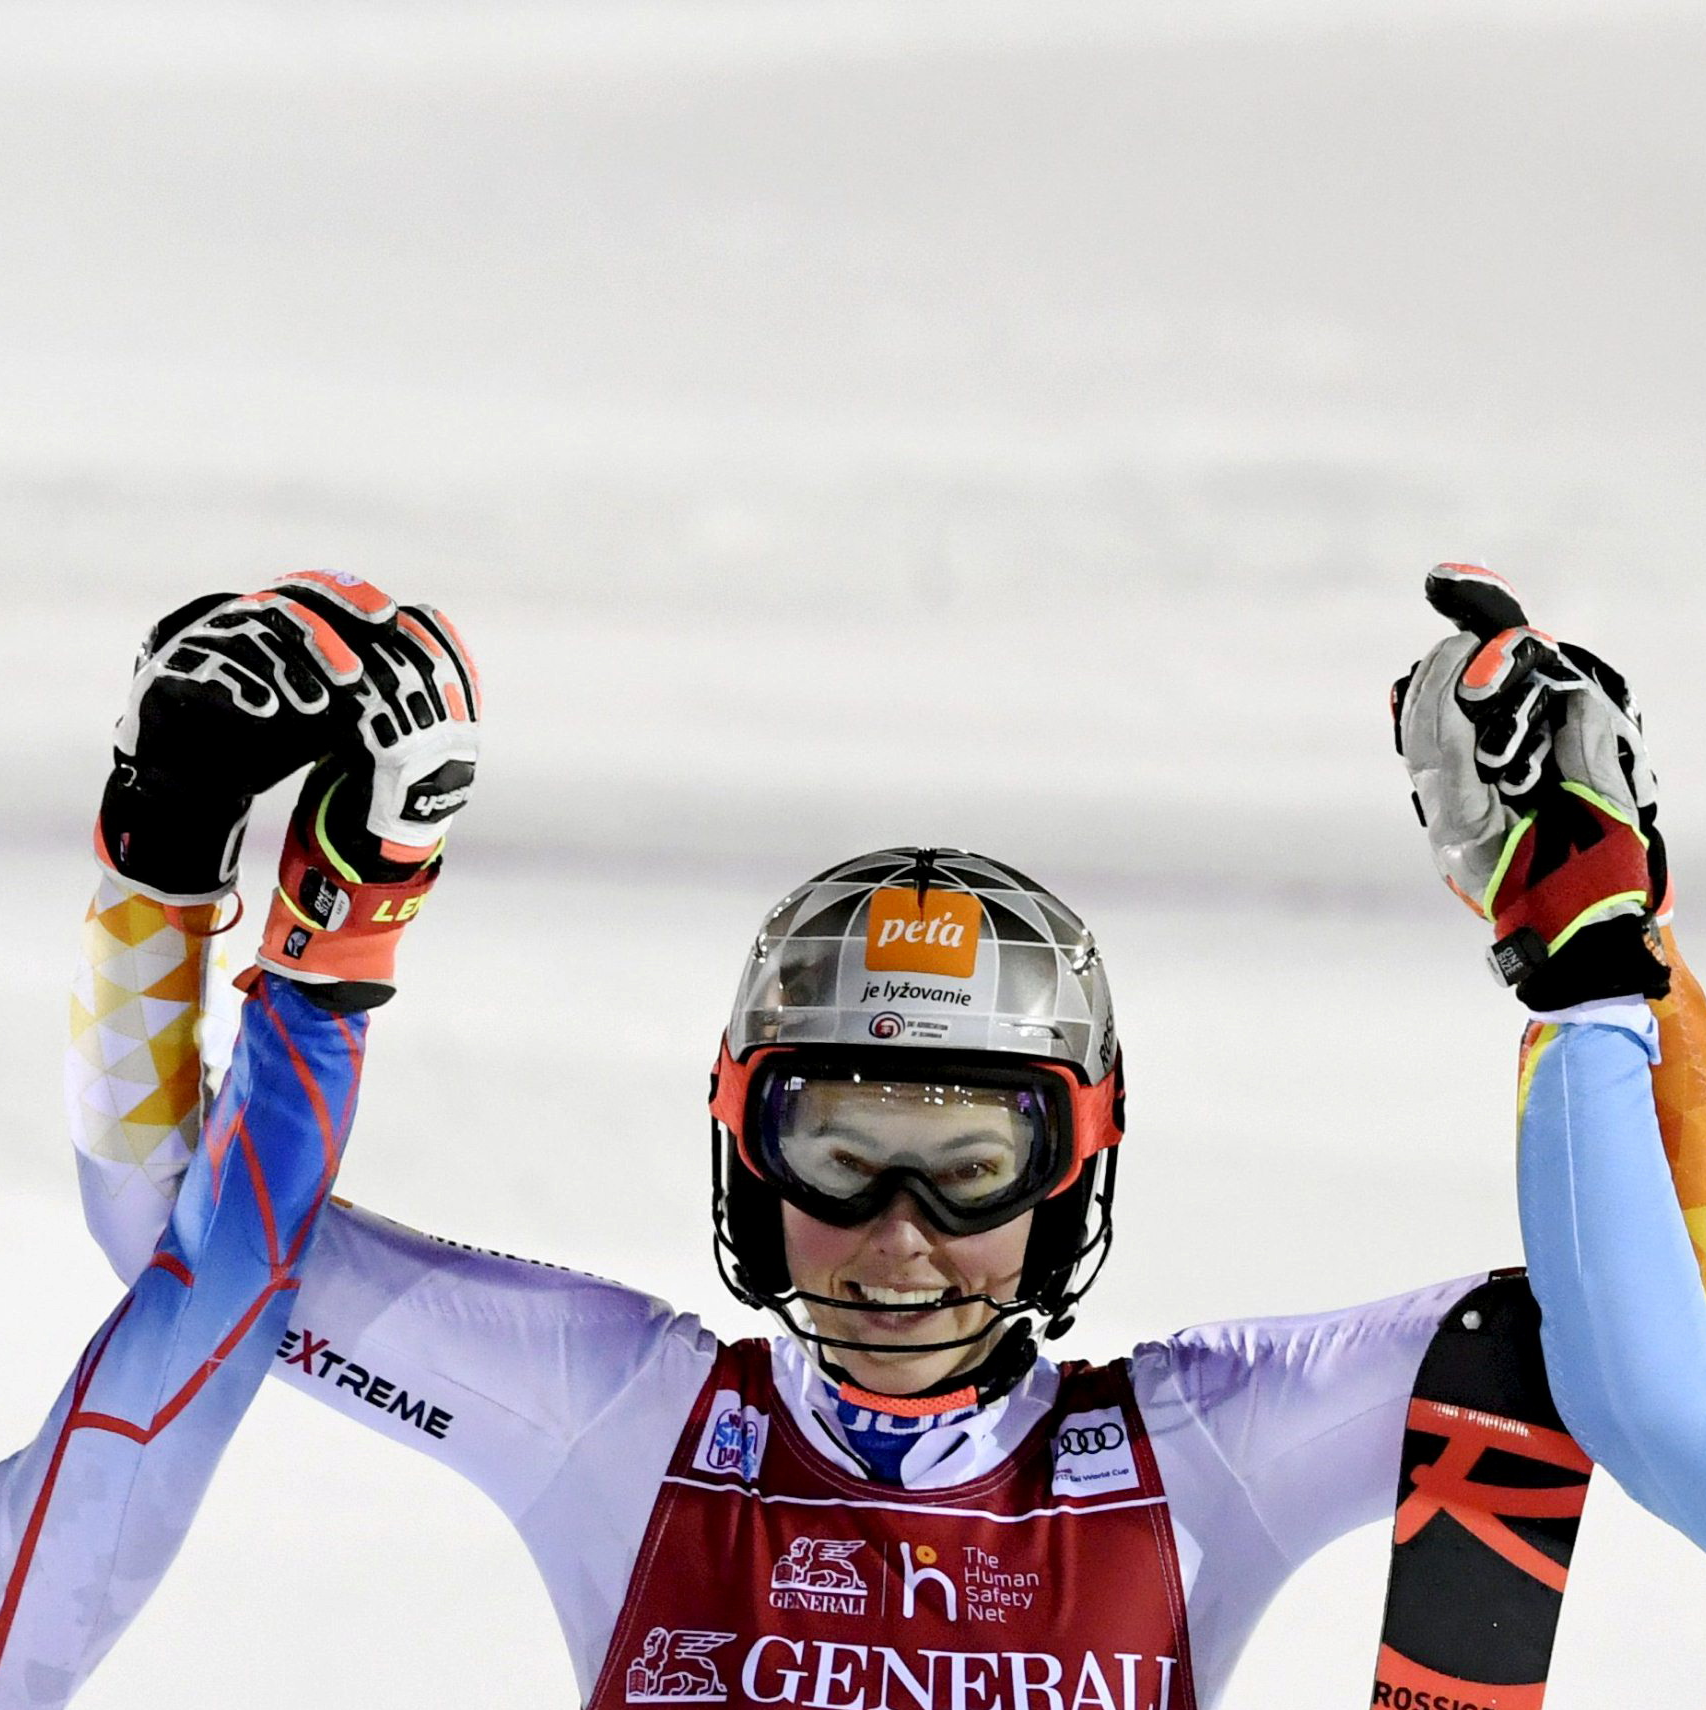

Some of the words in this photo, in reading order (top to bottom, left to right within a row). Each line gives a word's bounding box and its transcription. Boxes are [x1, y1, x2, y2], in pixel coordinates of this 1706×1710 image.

[860, 981, 880, 1003] je
[883, 981, 972, 1007] lyžovanie
[963, 1546, 1000, 1568] The
[965, 1567, 1041, 1588] Human
[769, 1591, 866, 1617] GENERALI
[966, 1587, 1034, 1611] Safety
[967, 1603, 1007, 1624] Net
